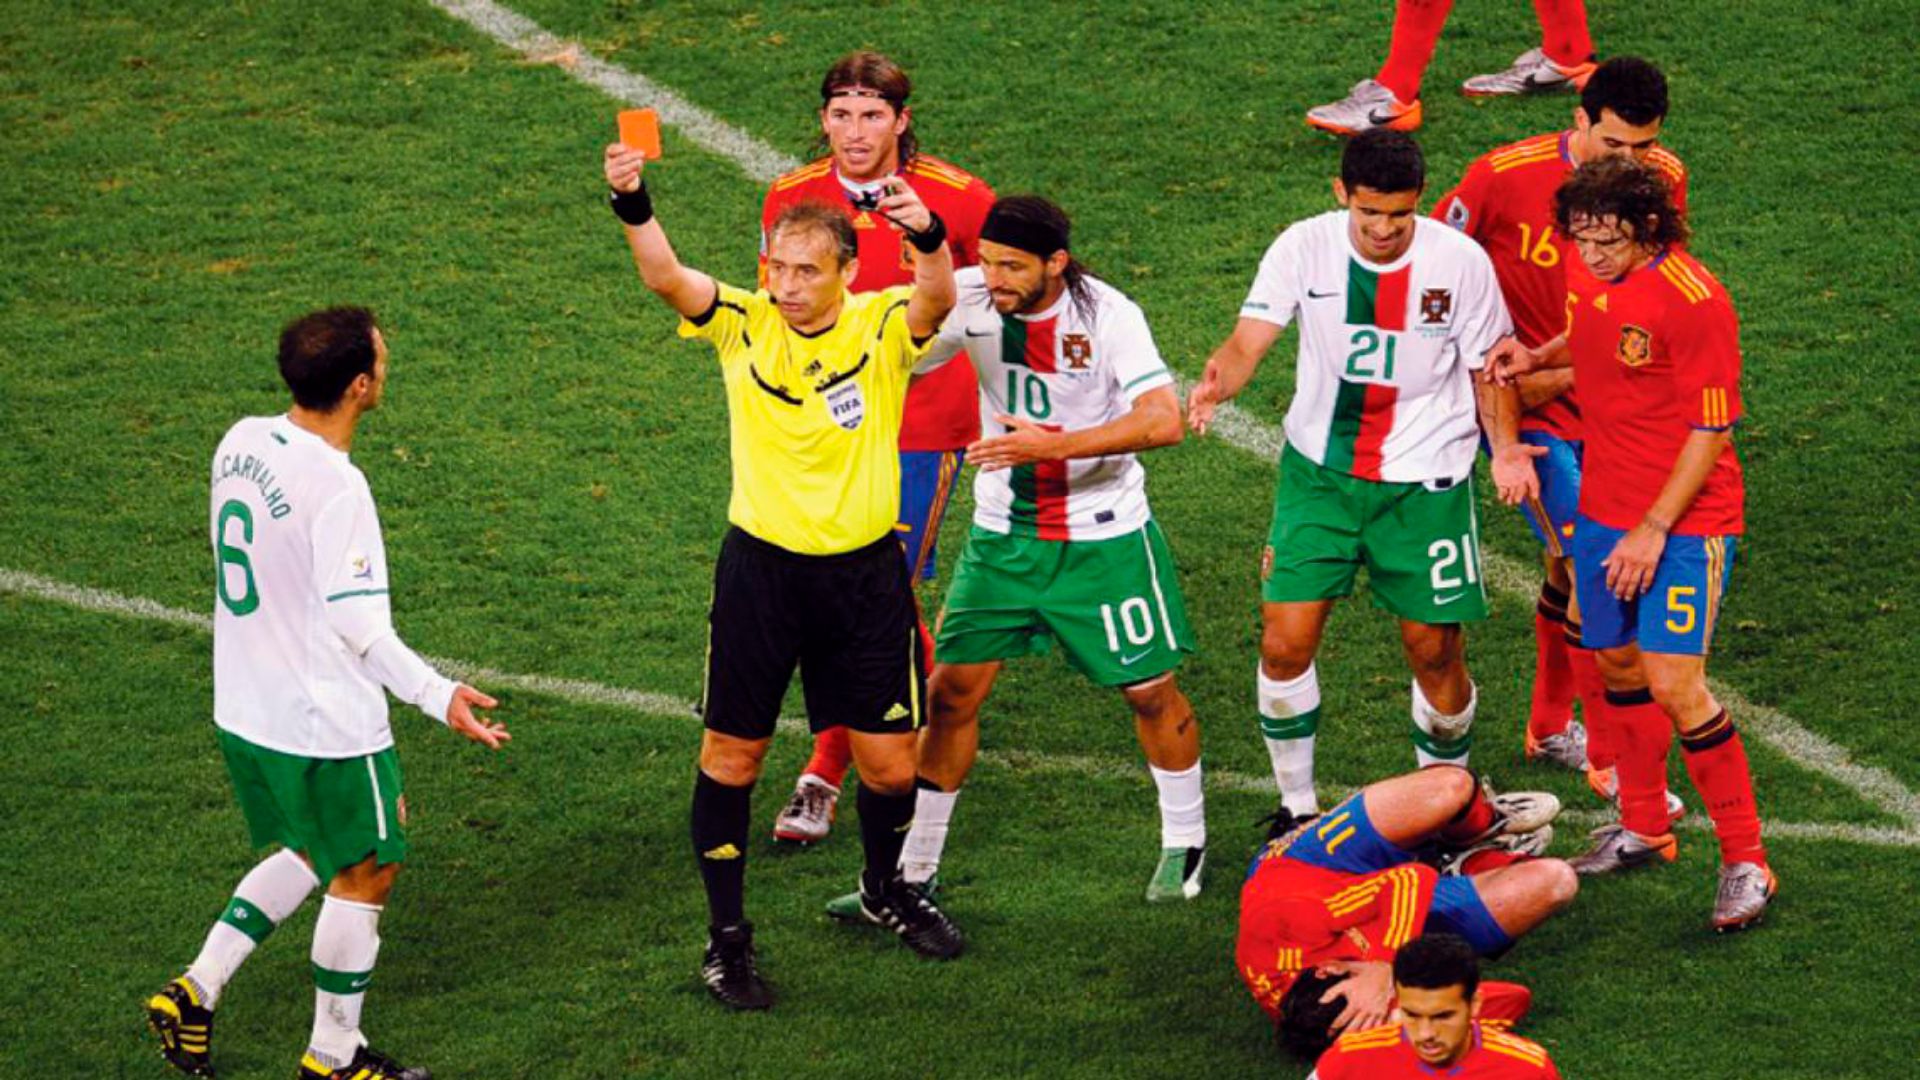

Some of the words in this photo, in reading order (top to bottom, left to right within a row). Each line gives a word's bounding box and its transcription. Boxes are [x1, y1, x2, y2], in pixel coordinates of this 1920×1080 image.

[1517, 223, 1560, 267] 16
[1346, 329, 1397, 379] 21
[832, 398, 861, 417] FIFA
[1008, 369, 1051, 419] 10
[221, 453, 291, 519] CARVALHO
[218, 499, 260, 616] 6
[1428, 533, 1478, 589] 21
[1101, 597, 1155, 652] 10
[1665, 587, 1696, 633] 5
[1317, 812, 1356, 855] 11
